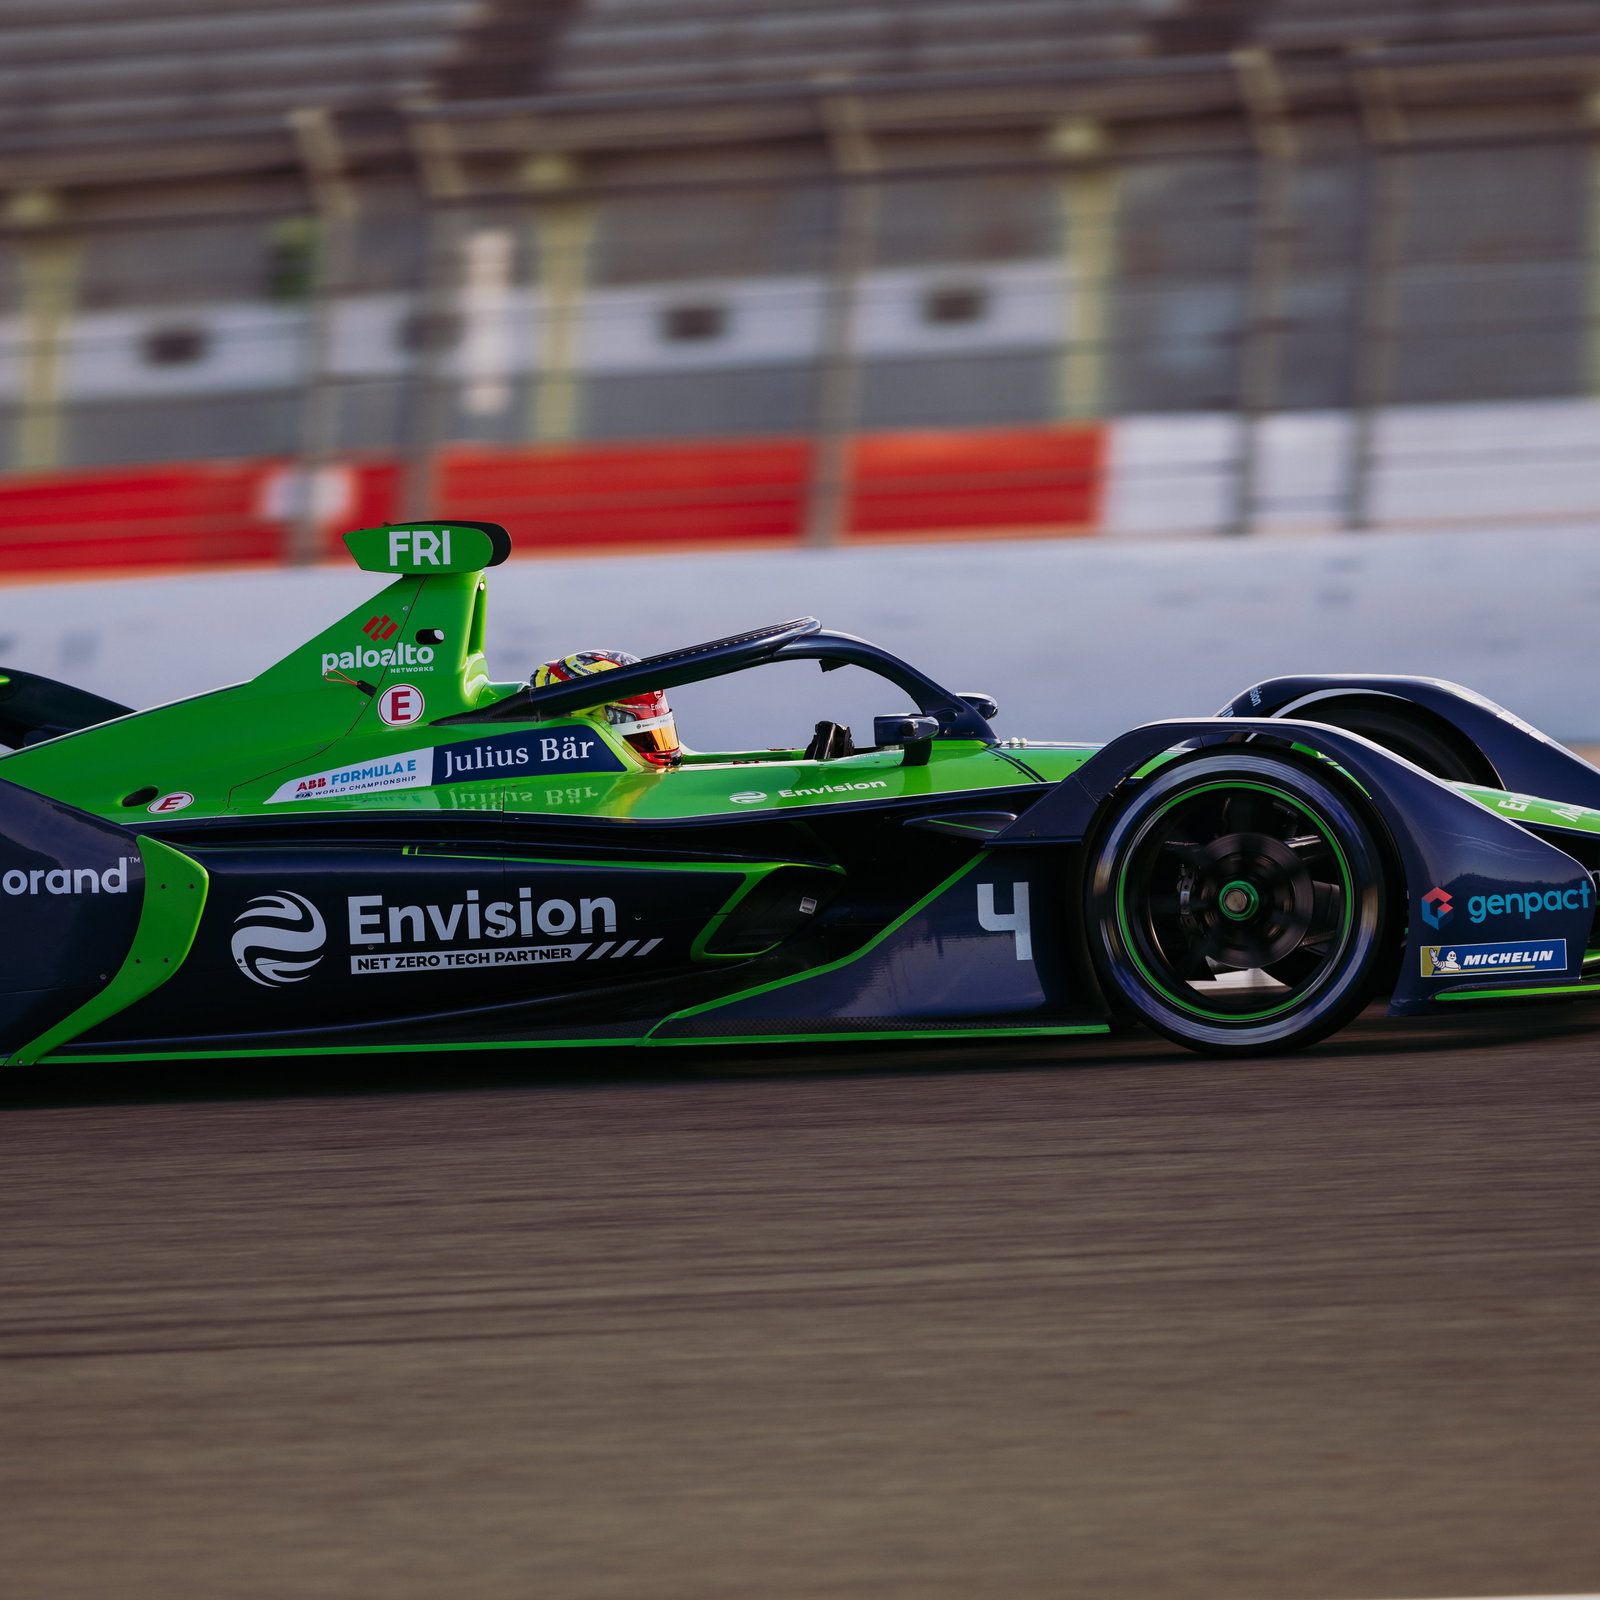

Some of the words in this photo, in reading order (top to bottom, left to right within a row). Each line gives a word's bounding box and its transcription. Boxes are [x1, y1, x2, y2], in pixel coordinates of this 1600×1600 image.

[389, 530, 451, 566] FRI
[321, 642, 434, 676] paloalto
[391, 691, 411, 721] E
[444, 745, 529, 778] Julius
[539, 736, 594, 762] Bär
[296, 777, 327, 792] ABB
[331, 762, 404, 786] FORMULA
[407, 759, 417, 772] E
[315, 787, 346, 796] WORLD
[349, 775, 417, 791] CHAMPIONSHIP
[777, 780, 887, 798] Envision
[157, 796, 184, 810] E
[2, 857, 128, 895] orand
[347, 887, 617, 945] Envision
[1467, 880, 1591, 923] genpact
[976, 881, 1033, 961] 4
[357, 957, 390, 970] NET
[395, 954, 440, 969] ZERO
[444, 952, 490, 966] TECH
[494, 947, 572, 963] PARTNER
[1463, 950, 1554, 966] MICHELIN
